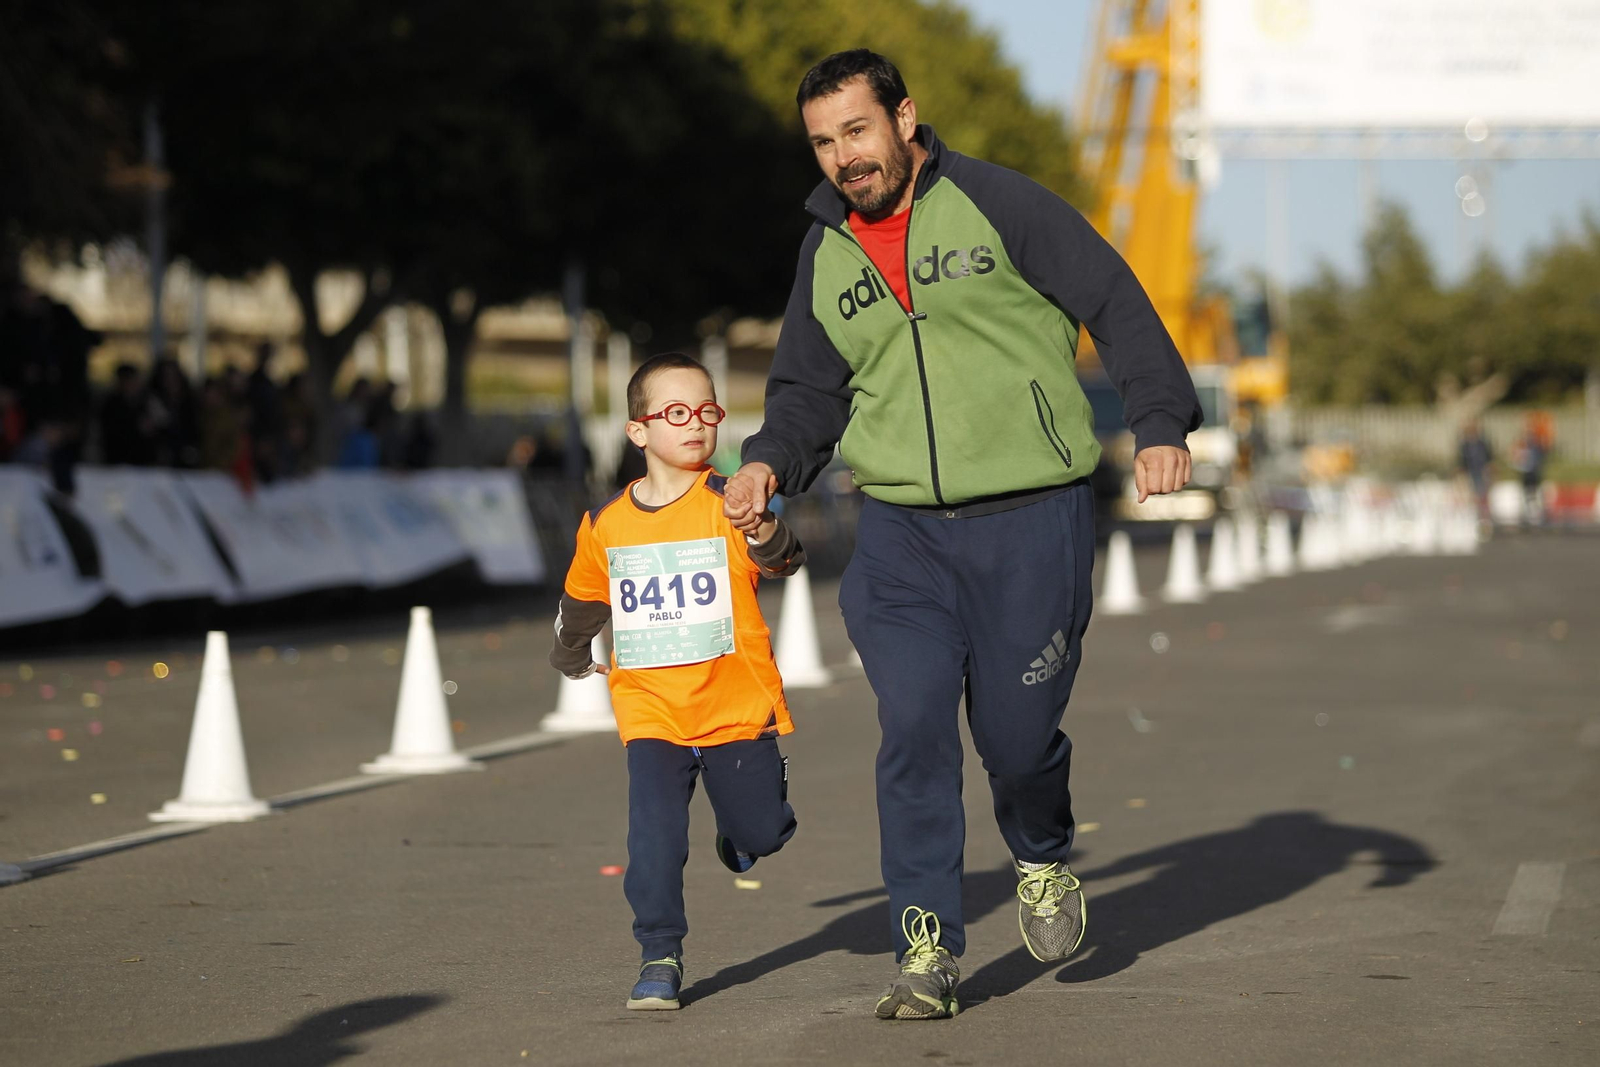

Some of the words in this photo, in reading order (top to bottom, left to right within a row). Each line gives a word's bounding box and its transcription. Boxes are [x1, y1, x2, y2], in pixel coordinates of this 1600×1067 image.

[676, 547, 717, 557] CARRERA
[678, 556, 718, 567] INFANTIL
[620, 572, 717, 613] 8419
[649, 611, 683, 621] PABLO
